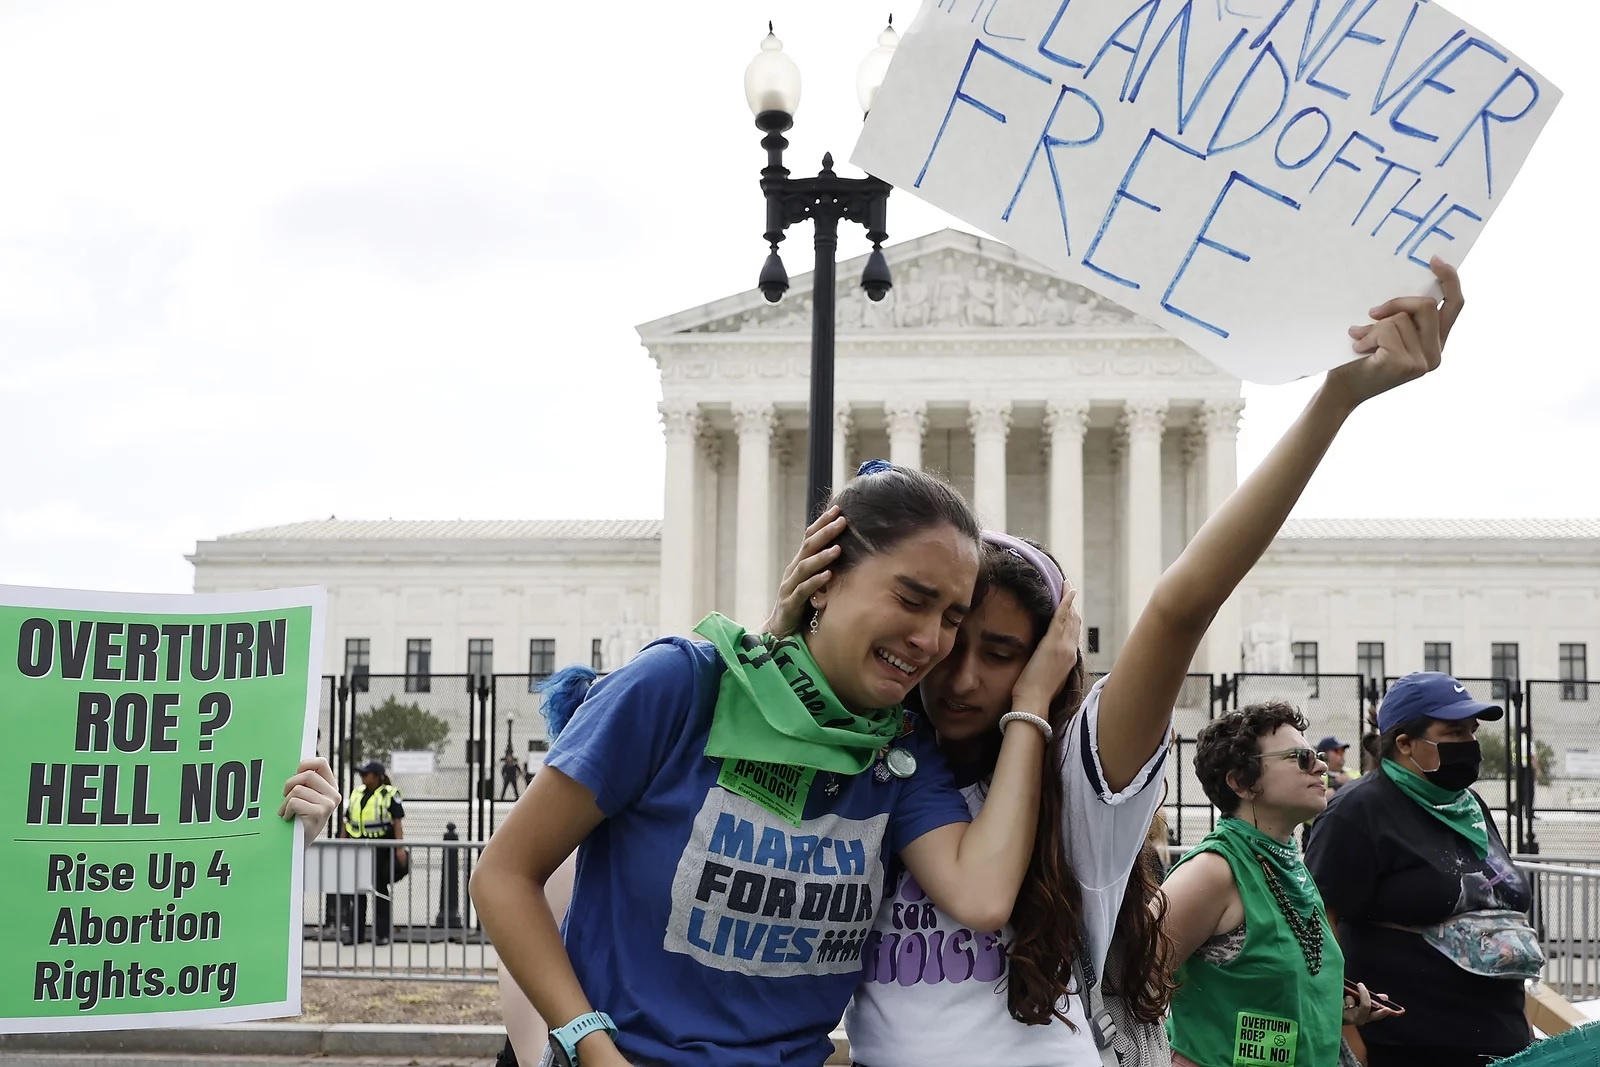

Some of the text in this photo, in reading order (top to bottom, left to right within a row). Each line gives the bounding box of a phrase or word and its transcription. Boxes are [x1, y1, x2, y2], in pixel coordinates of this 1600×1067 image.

[1037, 0, 1290, 159] LAND
[1249, 0, 1540, 200] NEVER
[913, 38, 1302, 340] FREE
[16, 616, 288, 683] OVERTURN
[73, 690, 233, 754] ROE ?
[26, 758, 264, 827] HELL NO!
[733, 758, 798, 808] APOLOGY!
[753, 760, 802, 789] HOUT
[708, 811, 866, 876] MARCH
[46, 849, 232, 899] Rise Up 4
[695, 859, 798, 919] FOR
[796, 881, 874, 923] OUR
[48, 903, 221, 948] Abortion
[687, 905, 821, 964] LIVES
[891, 902, 938, 930] FOR
[33, 958, 238, 1012] Rights.org
[861, 929, 1007, 987] HOICE
[1238, 1042, 1291, 1064] HELL NO!
[1240, 1028, 1266, 1043] ROE?
[1241, 1015, 1291, 1034] OVERTURN
